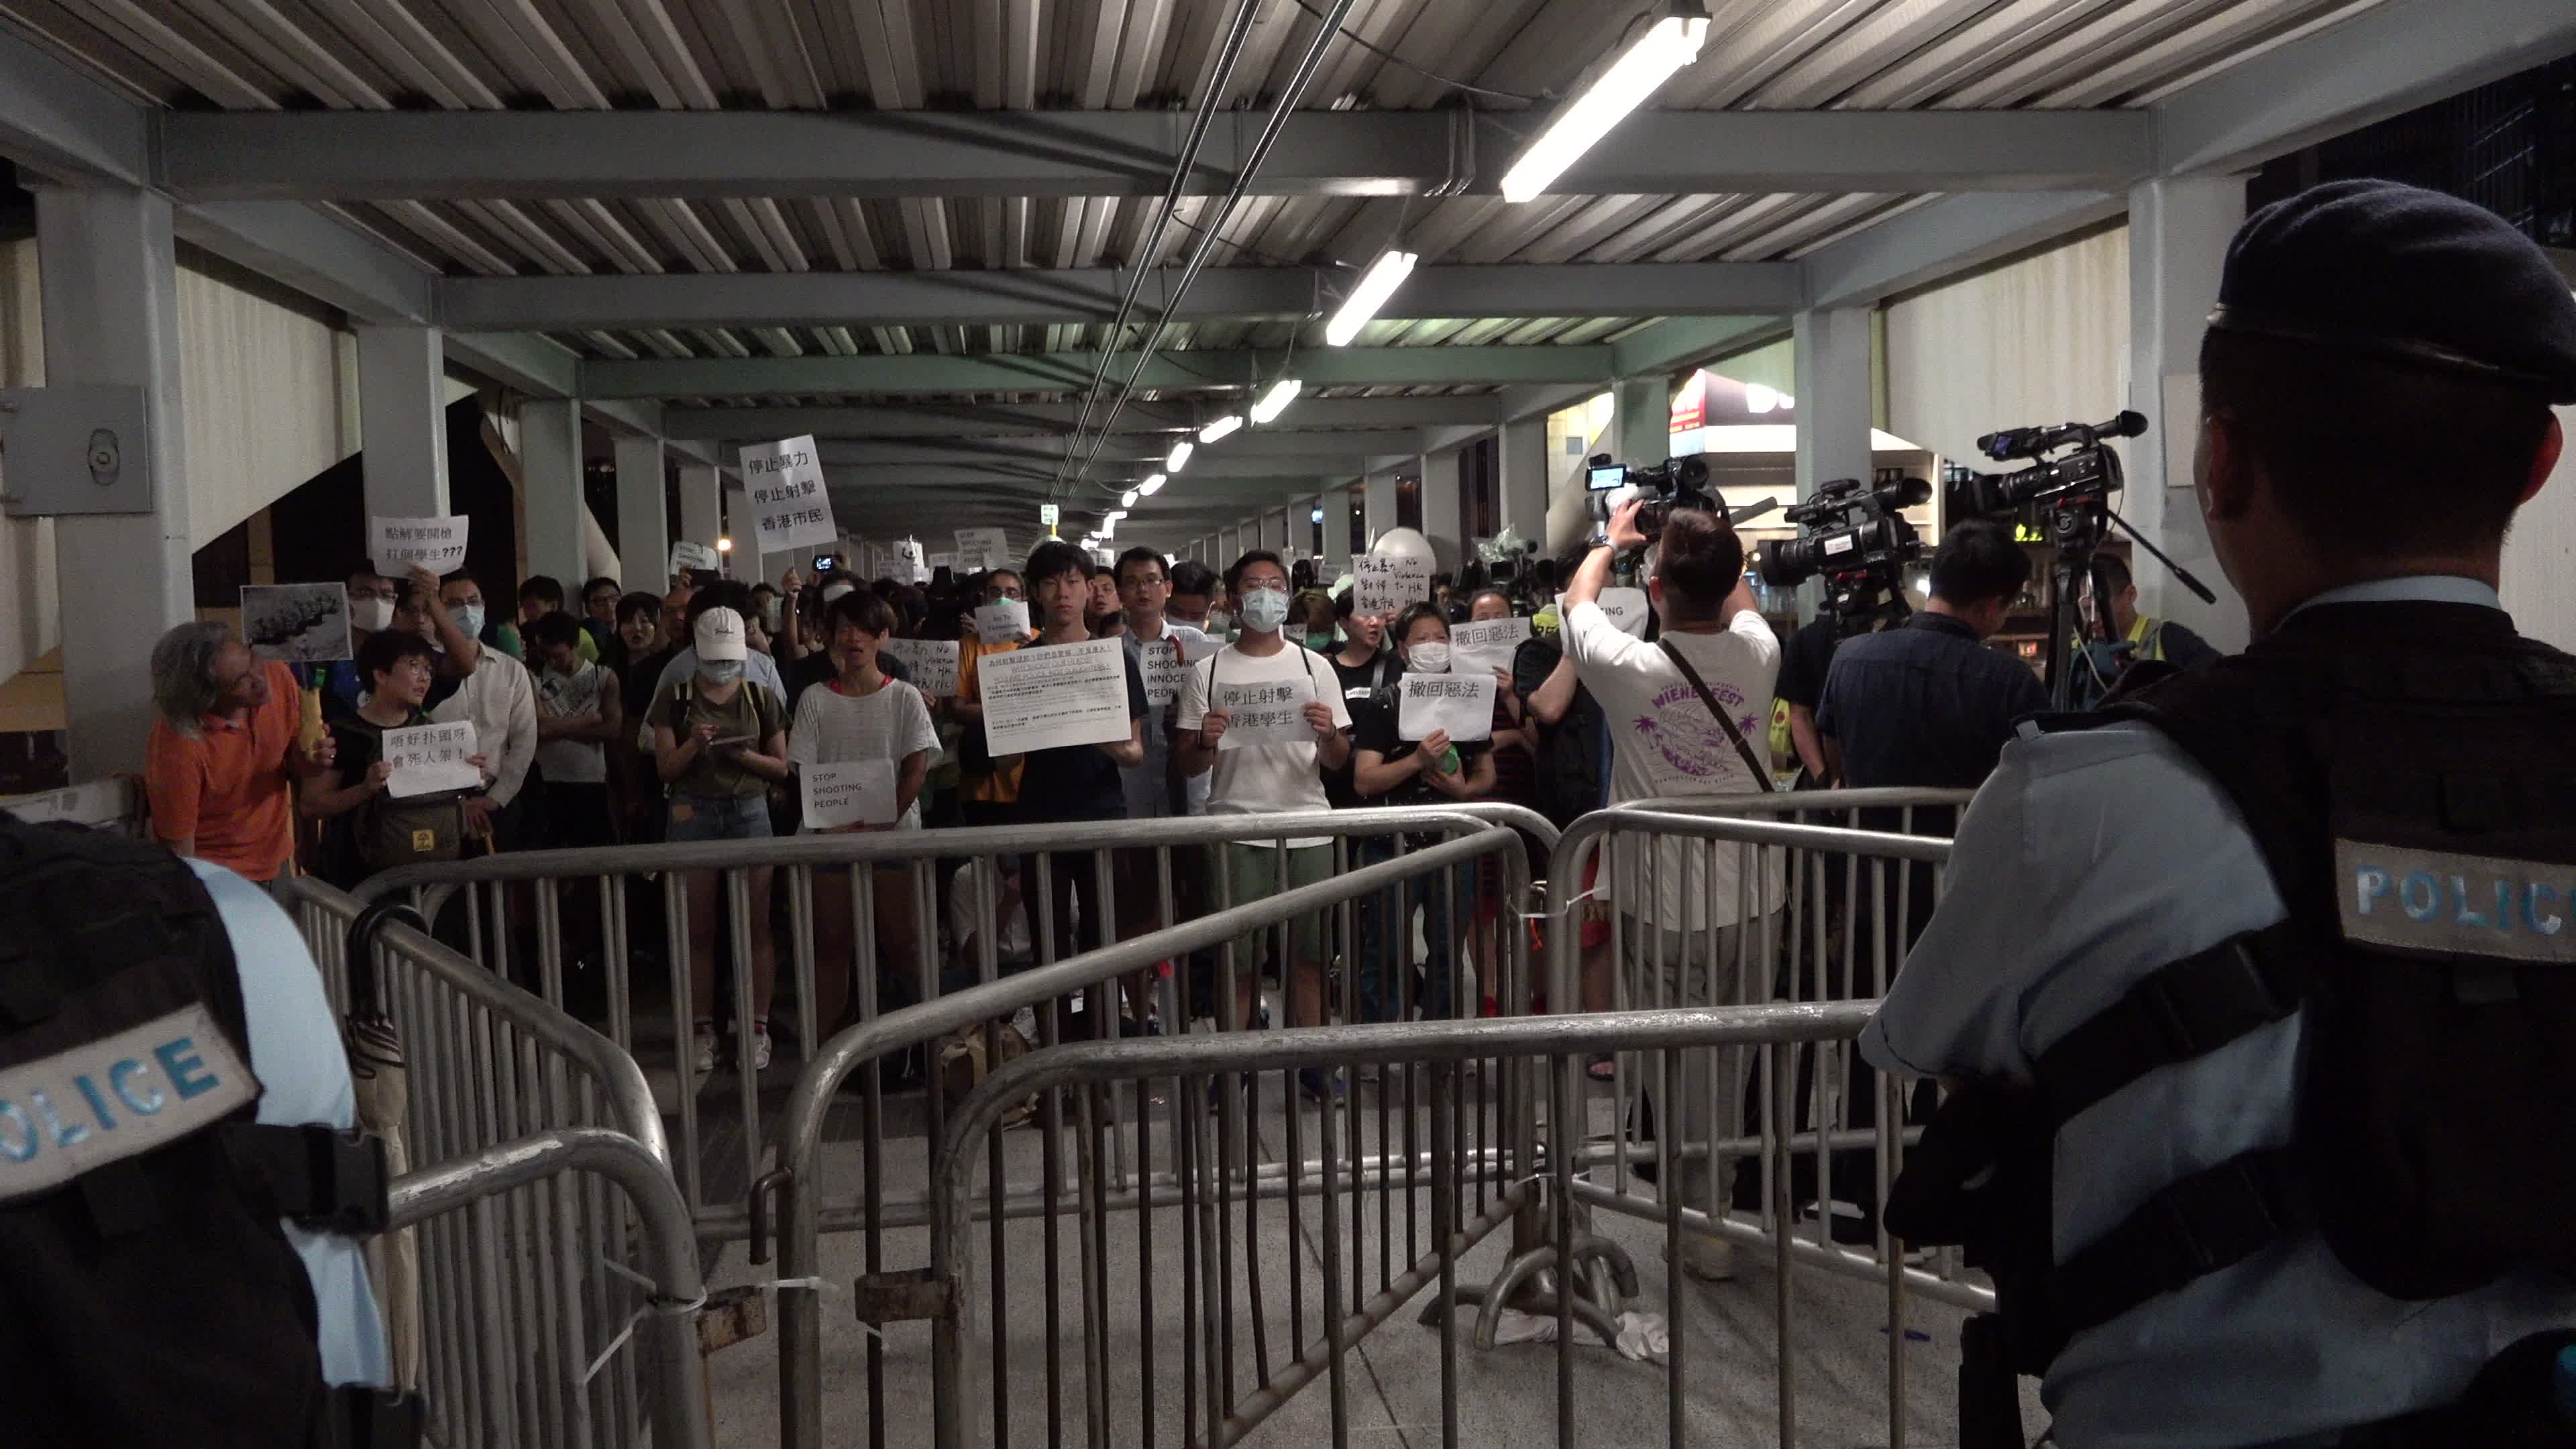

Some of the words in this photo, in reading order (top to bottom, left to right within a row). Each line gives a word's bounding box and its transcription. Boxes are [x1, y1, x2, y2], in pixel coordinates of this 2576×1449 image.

[749, 451, 809, 474] 停止暴力
[754, 480, 816, 504] 停止射擊
[762, 508, 824, 532] 香港市民
[1456, 624, 1519, 646] 撤回惡法
[1148, 646, 1176, 655] STOP
[1147, 674, 1187, 684] INNOCE
[1223, 686, 1293, 706] 停止射擊
[1409, 681, 1480, 698] 撤回惡法
[1228, 711, 1294, 729] 香港學生
[812, 773, 837, 783] STOP
[813, 783, 863, 796] SHOOTING
[814, 798, 849, 809] PEOPLE
[2355, 864, 2576, 935] POLIC
